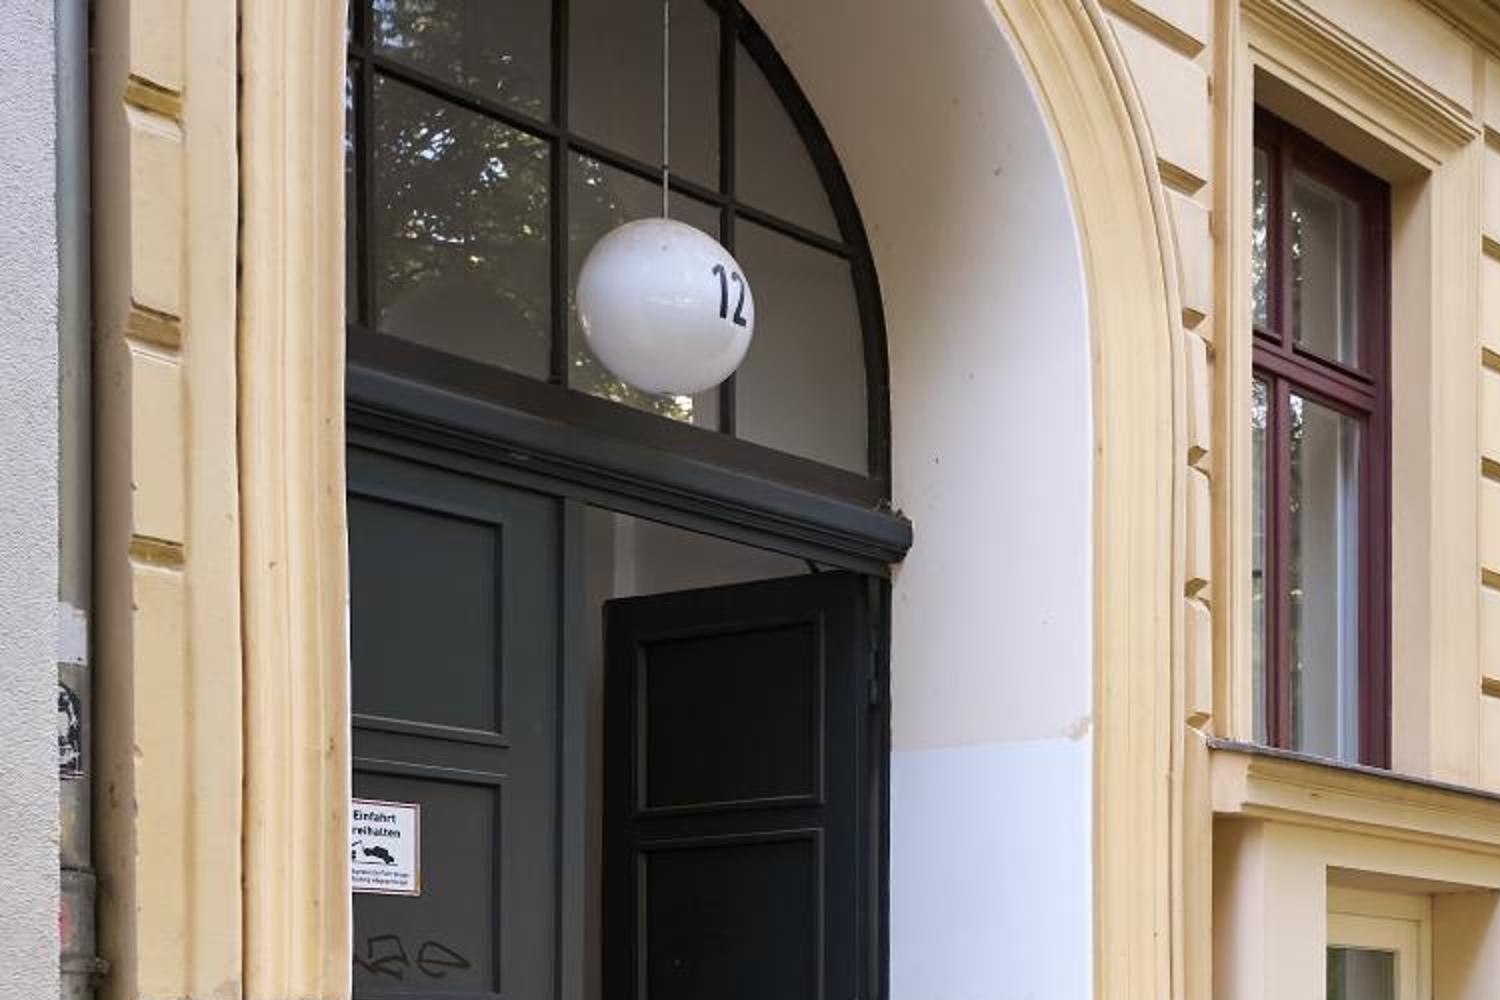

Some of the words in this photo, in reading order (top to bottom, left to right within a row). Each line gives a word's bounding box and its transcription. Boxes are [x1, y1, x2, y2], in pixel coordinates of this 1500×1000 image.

[713, 264, 746, 327] 12
[353, 810, 397, 824] Einfahrt
[352, 825, 401, 838] reihalten
